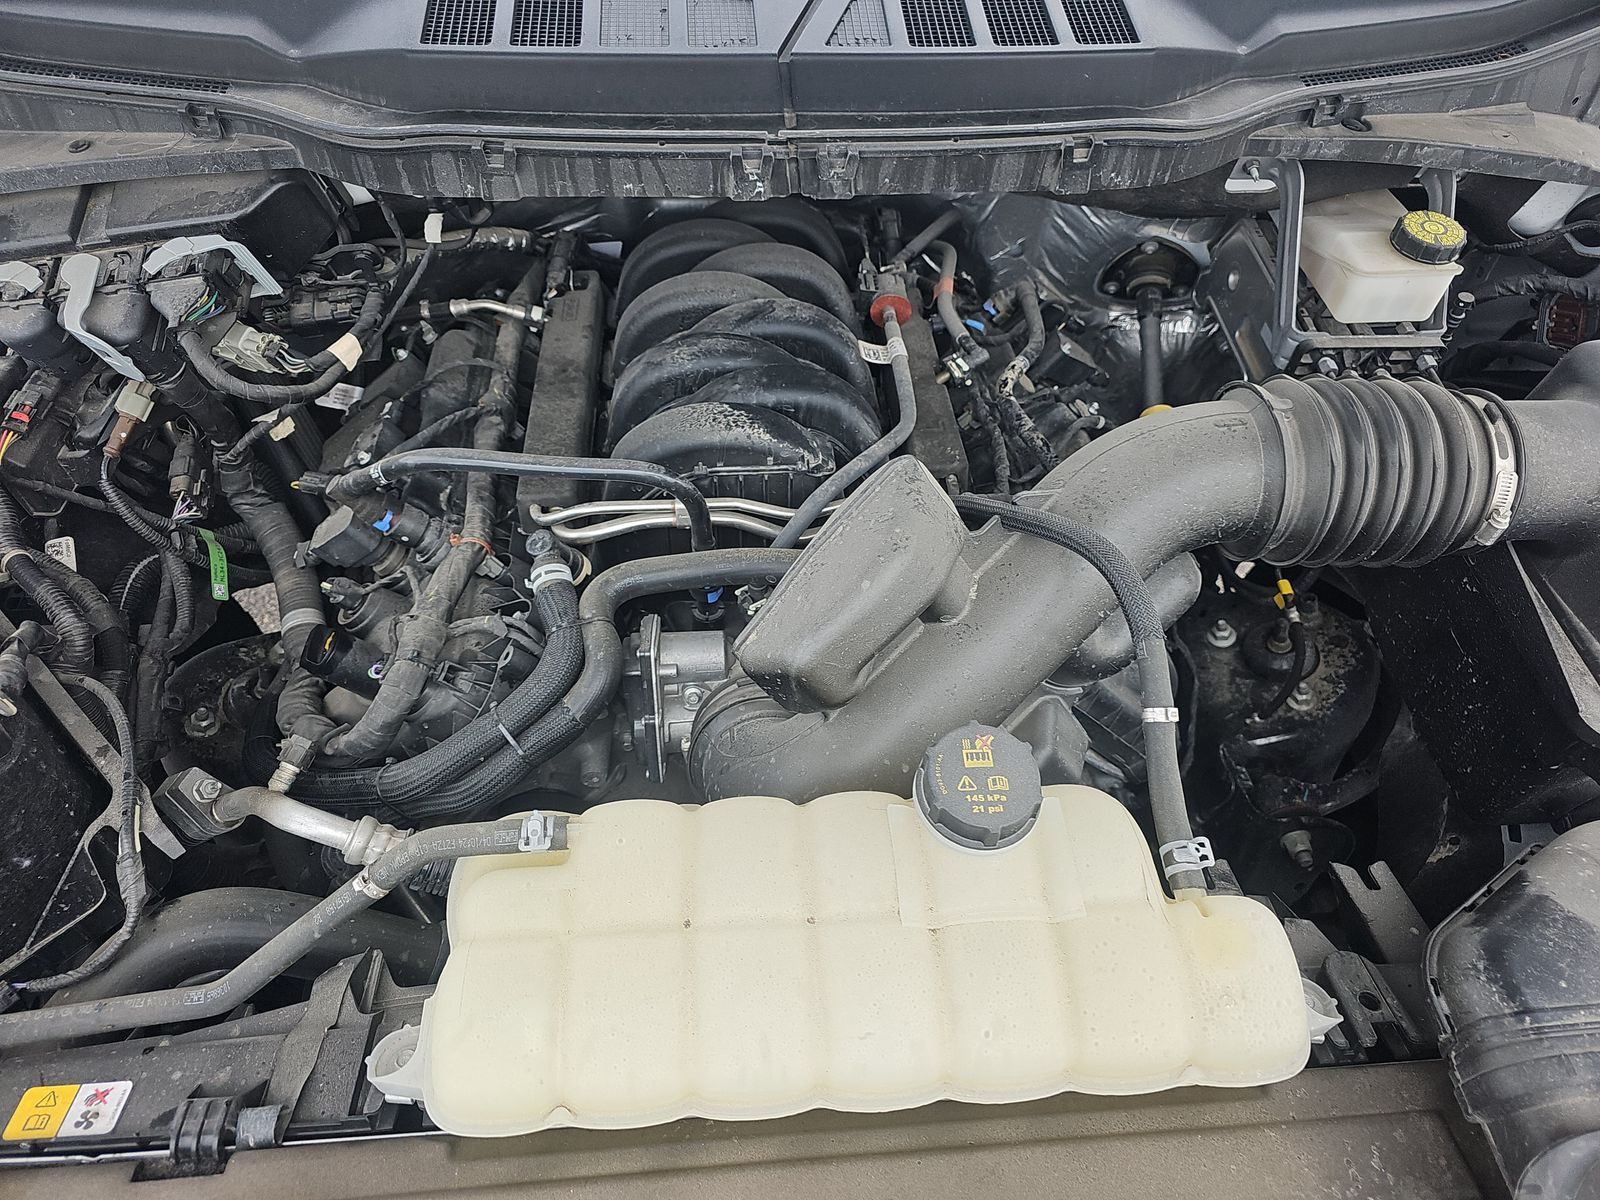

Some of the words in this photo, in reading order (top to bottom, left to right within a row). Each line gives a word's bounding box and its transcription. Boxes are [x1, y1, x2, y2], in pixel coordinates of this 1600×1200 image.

[965, 794, 985, 802] 145
[986, 794, 1007, 802] kPa
[972, 805, 985, 813] 21
[988, 804, 1004, 814] psi
